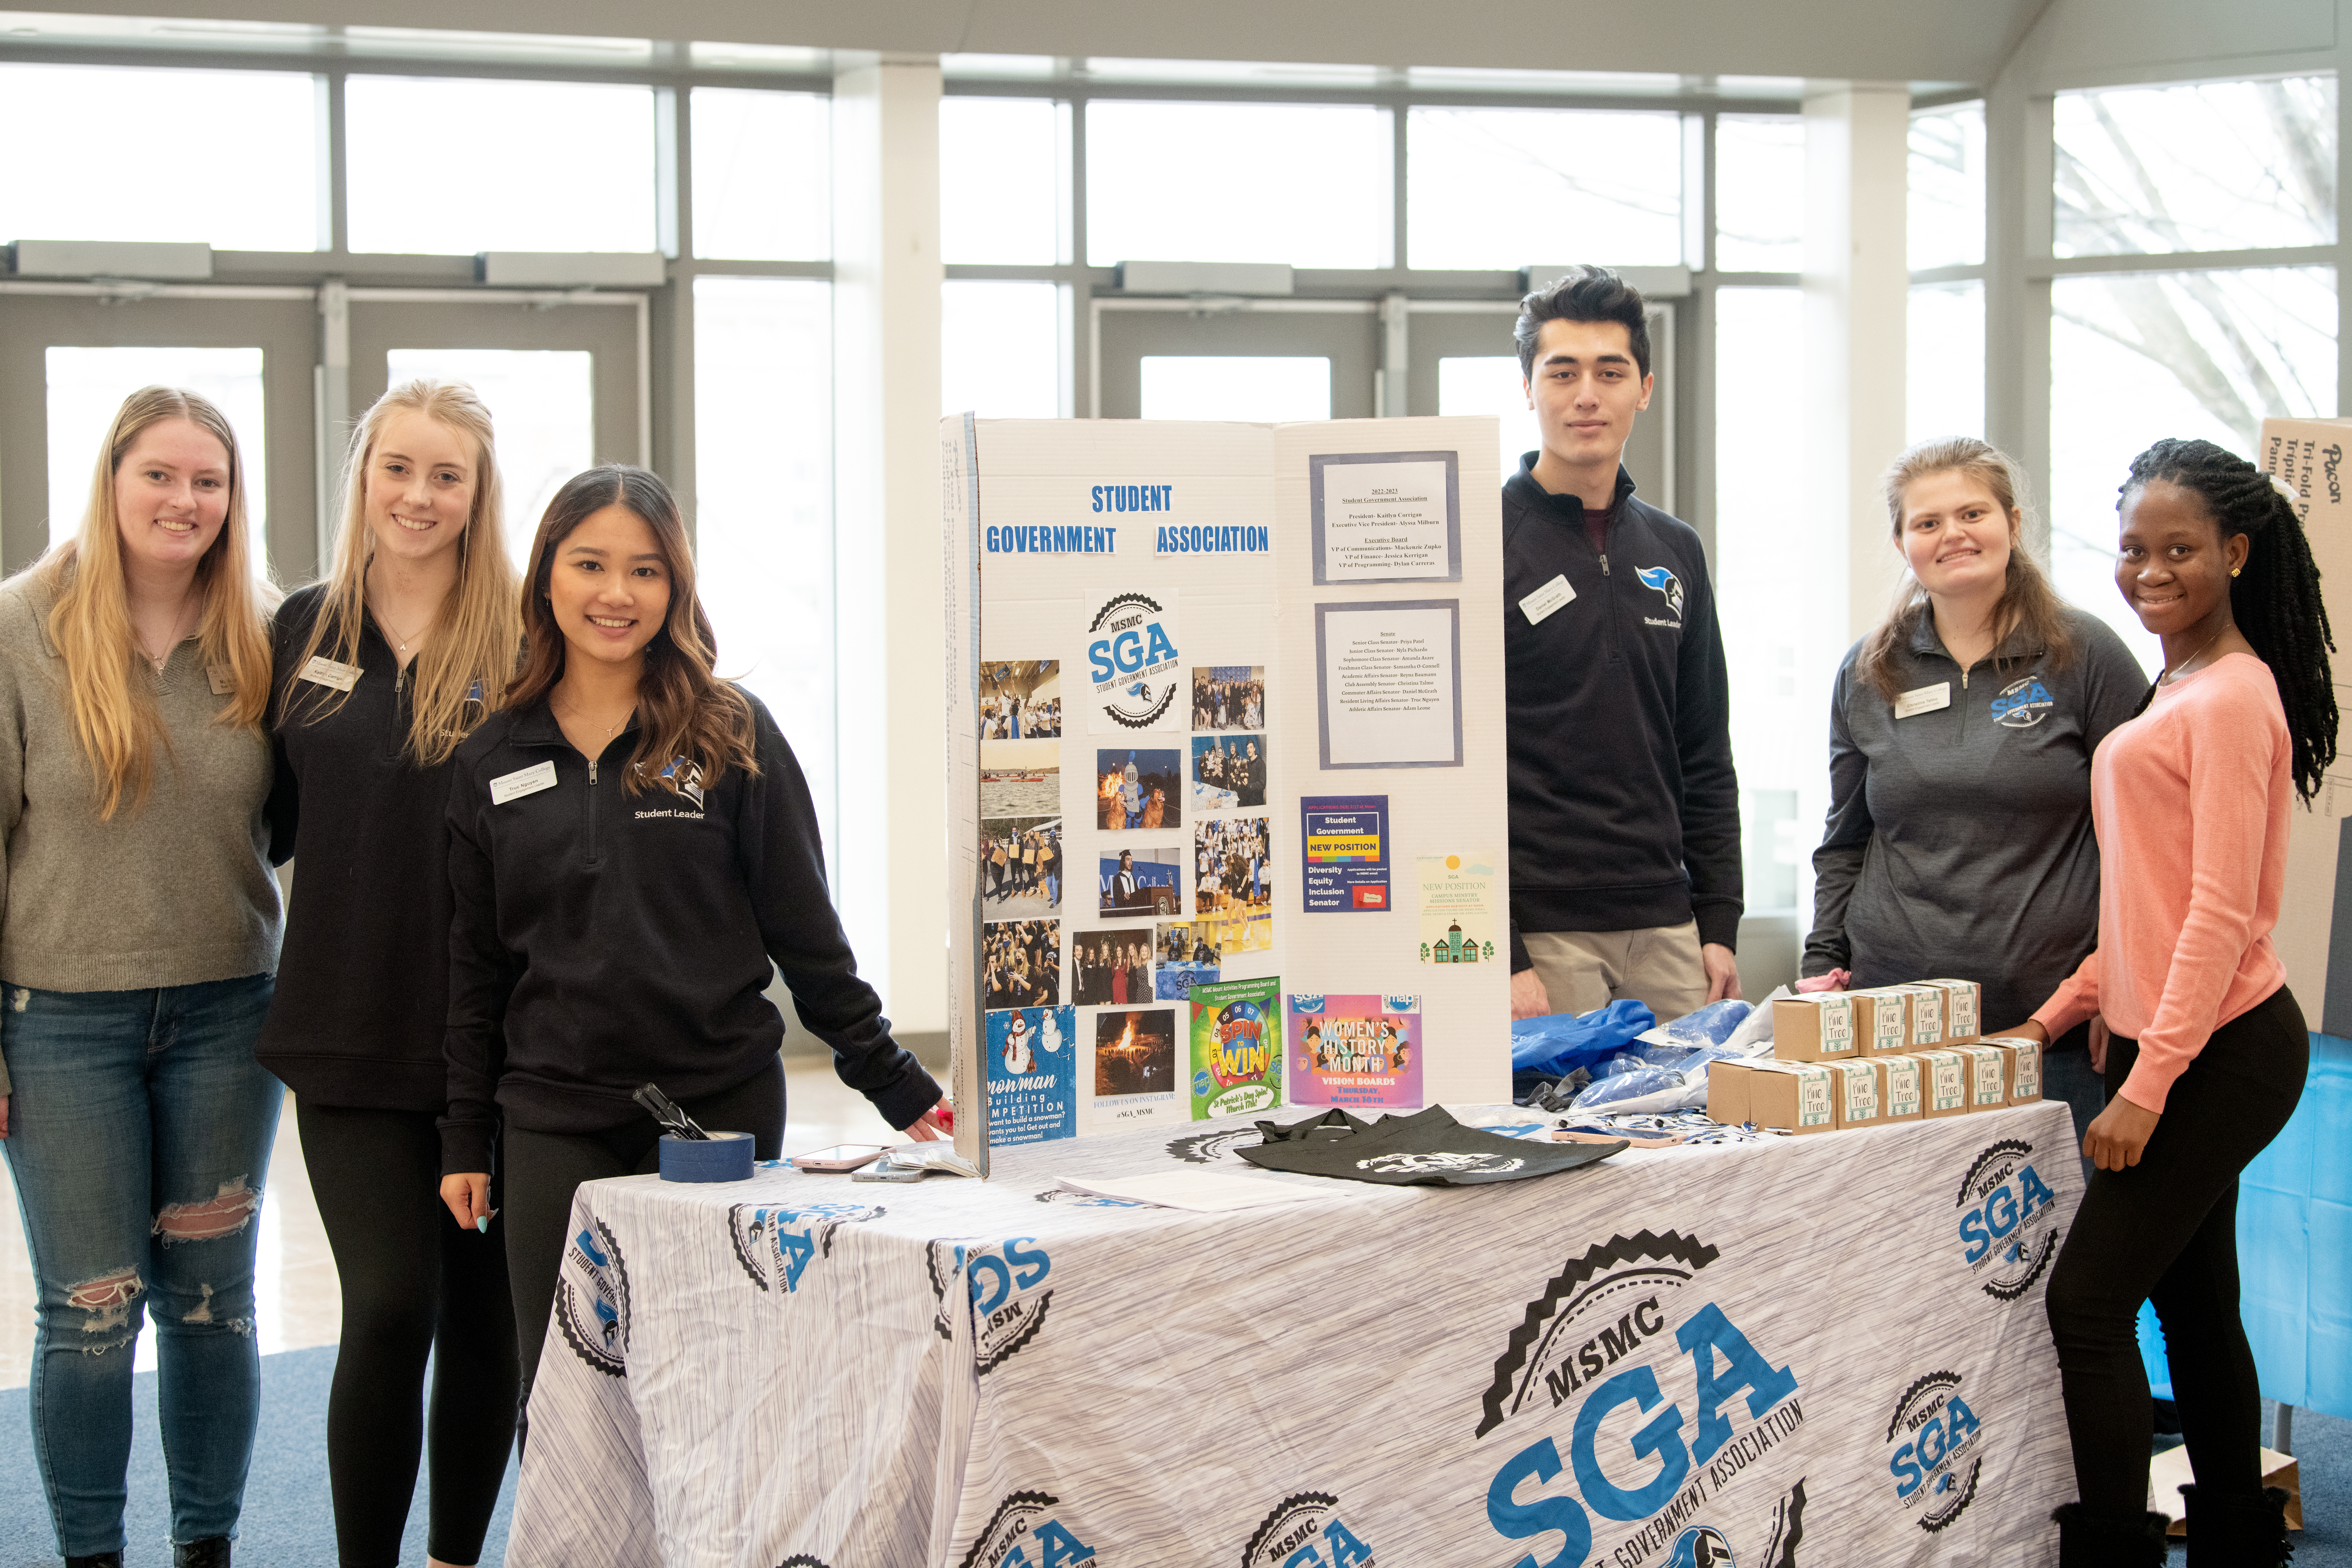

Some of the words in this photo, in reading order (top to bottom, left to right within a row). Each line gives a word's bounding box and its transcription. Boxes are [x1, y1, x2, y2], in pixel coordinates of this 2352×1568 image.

[2300, 441, 2315, 498] Tri-Fold
[2322, 443, 2343, 504] Pacon
[1092, 486, 1172, 512] STUDENT
[987, 526, 1116, 553] GOVERNMENT
[1157, 526, 1269, 552] ASSOCIATION
[1536, 602, 1547, 611] Daniel
[1547, 593, 1562, 603] McGrath
[1111, 614, 1143, 633] MSMC
[1644, 617, 1667, 626] Student
[1089, 622, 1179, 683] SGA
[1097, 680, 1117, 694] STUDENT
[1119, 669, 1148, 687] GOVERNMENT
[1149, 659, 1179, 676] ASSOCIATION
[2007, 680, 2030, 696] MSMC
[1991, 682, 2054, 718] SGA
[521, 779, 538, 788] Nguyen
[635, 809, 672, 818] Student
[674, 809, 705, 819] Leader
[1308, 867, 1342, 875] Diversity
[1308, 877, 1333, 886] Equity
[1445, 882, 1486, 890] POSITION
[1956, 1000, 1968, 1012] Pine
[1828, 1014, 1843, 1027] Pine
[1956, 1013, 1971, 1024] Tree
[1220, 1020, 1262, 1043] SPIN
[1319, 1021, 1389, 1037] WOMEN'S
[1828, 1028, 1847, 1039] Tree
[1324, 1039, 1386, 1055] HISTORY
[1216, 1046, 1265, 1077] WIN
[1330, 1056, 1380, 1072] MONTH
[2020, 1060, 2032, 1073] Pine
[987, 1074, 1057, 1094] nowman
[2019, 1073, 2033, 1084] Tree
[1093, 1100, 1119, 1109] FOLLOW
[1139, 1093, 1175, 1103] INSTAGRAM:
[1220, 1093, 1243, 1106] Patrick's
[1244, 1091, 1254, 1101] Day
[1254, 1087, 1268, 1098] Spin!
[1807, 1087, 1822, 1100] Pine
[1116, 1108, 1155, 1120] @SGA_MSMC
[1226, 1102, 1244, 1114] March
[1245, 1099, 1257, 1108] 17th!
[1807, 1101, 1825, 1112] Tree
[1012, 1115, 1028, 1124] build
[1034, 1111, 1065, 1122] snowman?
[989, 1136, 1006, 1144] make
[1012, 1131, 1043, 1141] snowman!
[1977, 1161, 2013, 1200] MSMC
[1959, 1165, 2055, 1264] SGA
[1972, 1250, 1993, 1275] STUDENT
[1993, 1225, 2023, 1256] GOVERNMENT
[2024, 1199, 2056, 1230] ASSOCIATION
[569, 1247, 599, 1280] STUDENT
[770, 1237, 789, 1294] ASSOCIATION
[1545, 1295, 1664, 1409] MSMC
[1906, 1393, 1944, 1433] MSMC
[1486, 1302, 1799, 1568] SGA
[1890, 1394, 1980, 1499] SGA
[1614, 1477, 1707, 1568] GOVERNMENT
[1710, 1398, 1803, 1492] ASSOCIATION
[1904, 1484, 1927, 1509] STUDENT
[988, 1517, 1028, 1568] MSMC
[1269, 1517, 1318, 1563] MSMC
